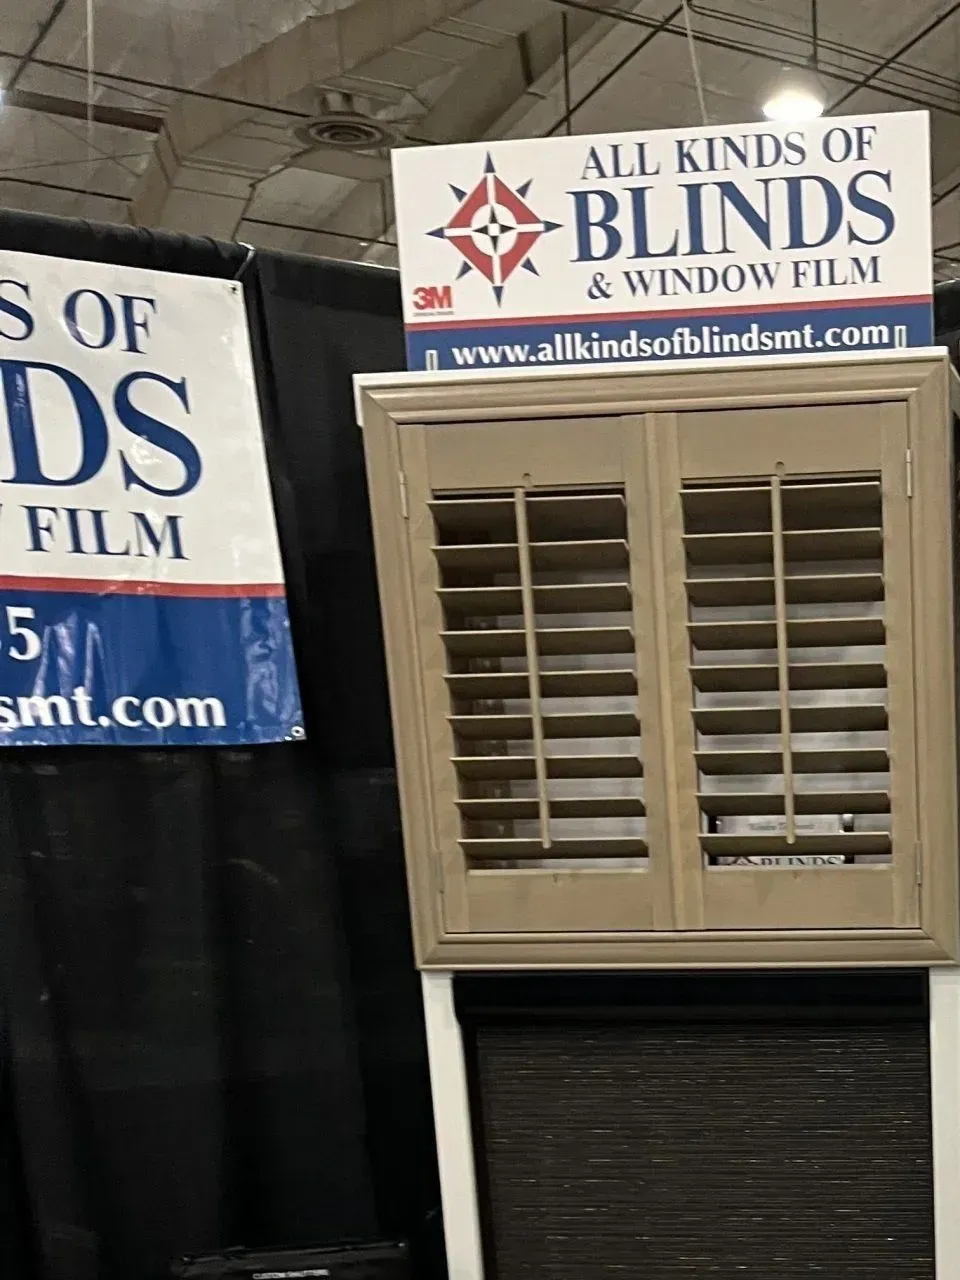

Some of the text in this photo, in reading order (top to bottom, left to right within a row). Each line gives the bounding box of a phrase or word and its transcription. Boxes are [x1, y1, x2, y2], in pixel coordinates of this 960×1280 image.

[580, 125, 877, 180] ALL KINDS OF
[566, 168, 895, 263] BLINDS
[412, 286, 452, 310] 3M
[587, 255, 881, 300] & WINDOW FILM
[62, 288, 157, 355] OF
[450, 322, 889, 366] www.allkindsofblindsmt.com
[19, 504, 190, 560] FILM
